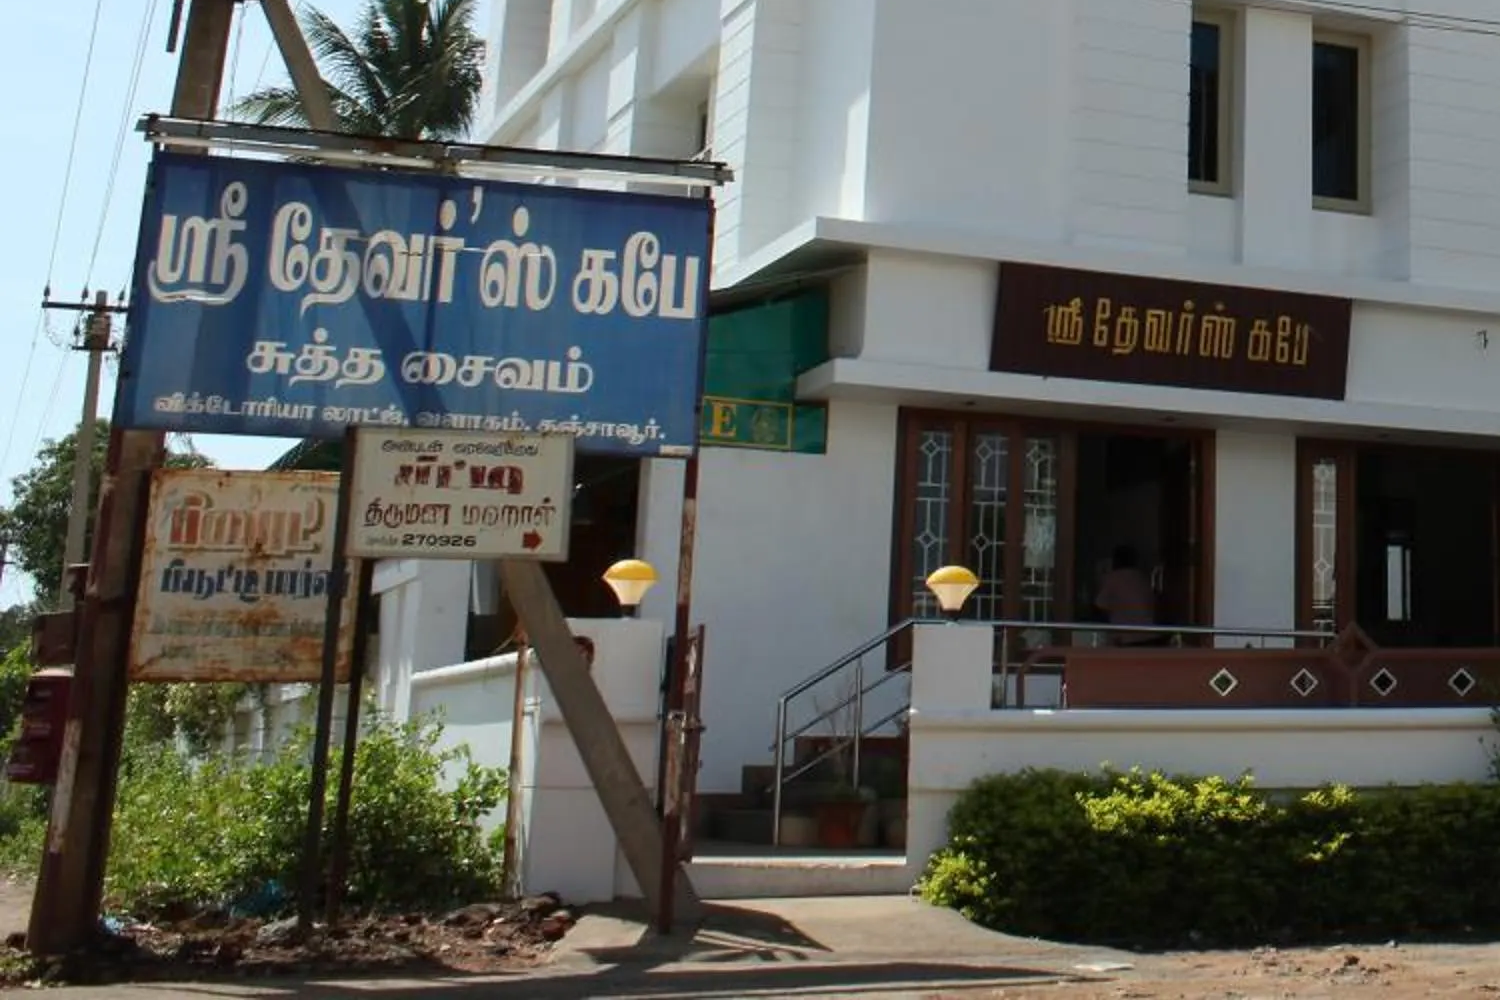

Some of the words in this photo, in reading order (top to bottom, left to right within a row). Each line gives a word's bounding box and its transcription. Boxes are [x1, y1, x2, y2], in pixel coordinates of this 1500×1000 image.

[572, 231, 700, 320] கபே
[246, 327, 386, 389] சுத்த
[401, 345, 594, 393] சைவம்
[1093, 297, 1236, 359] தேவர்ஸ்
[1247, 315, 1312, 366] கபே
[154, 391, 317, 420] விக்டோரியா
[401, 534, 477, 547] 270926
